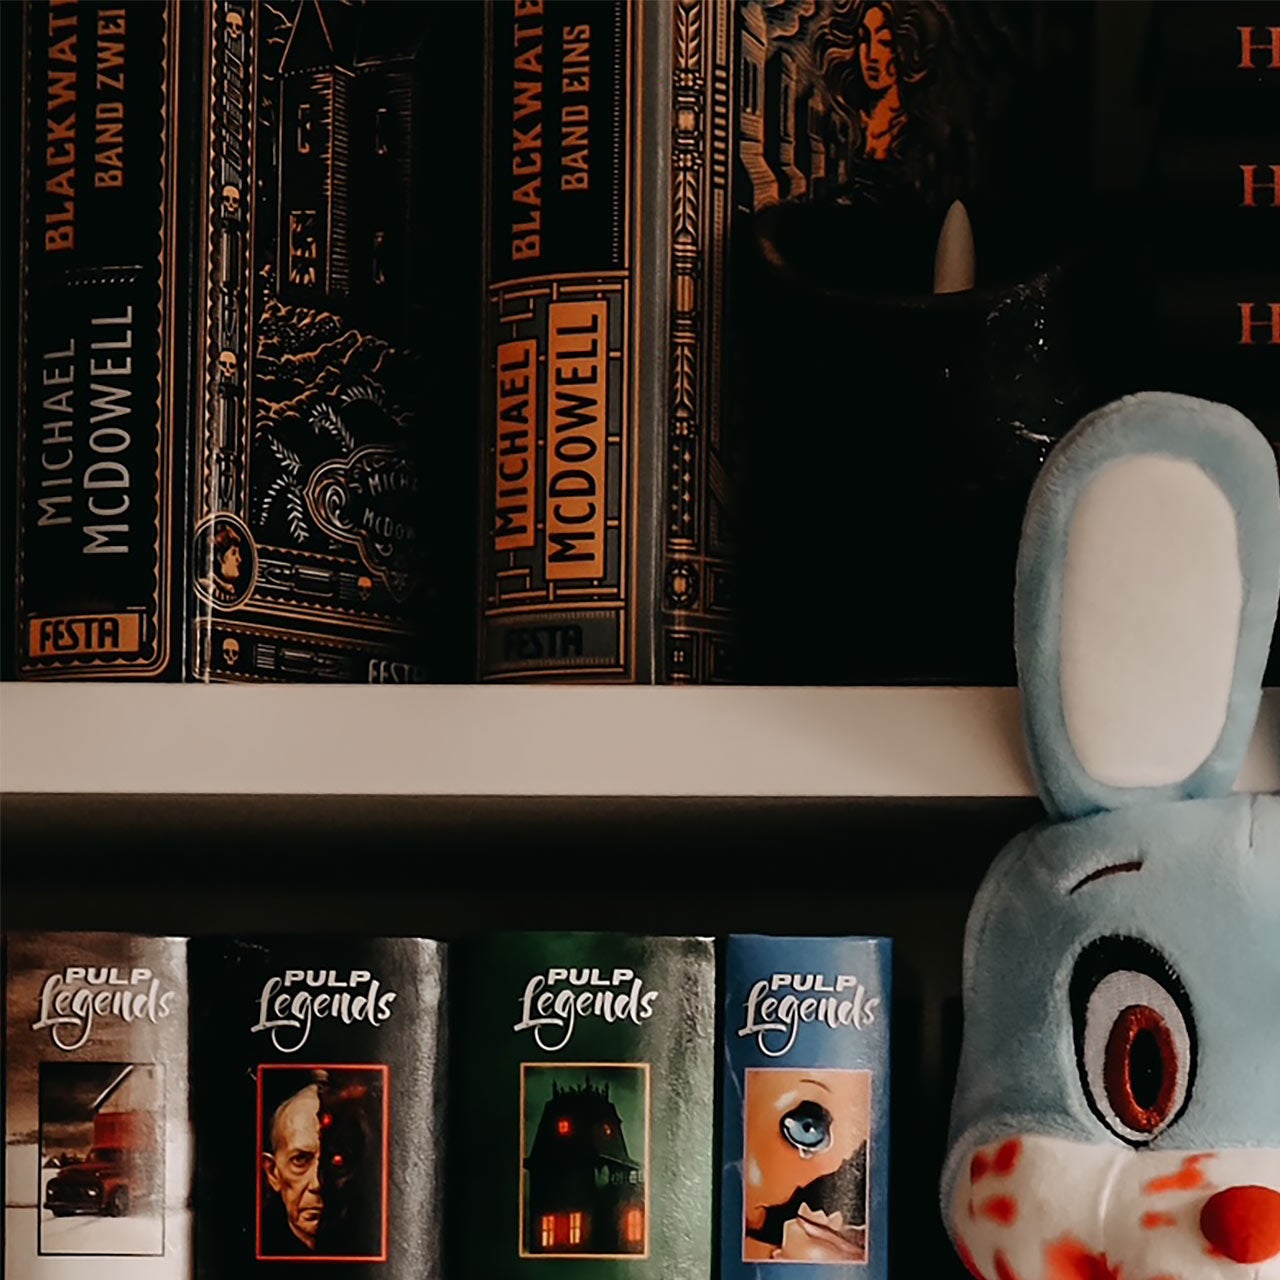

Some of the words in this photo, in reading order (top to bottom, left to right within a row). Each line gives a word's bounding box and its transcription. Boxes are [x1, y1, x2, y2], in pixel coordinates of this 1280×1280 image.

[96, 8, 128, 92] ZWEI
[562, 23, 592, 94] EINS
[94, 100, 127, 190] BAND
[560, 103, 591, 192] BAND
[36, 337, 76, 528] MICHAEL
[81, 304, 134, 556] MCDOWELL
[495, 348, 529, 539] MICHAEL
[548, 314, 600, 563] MCDOWELL
[39, 617, 120, 652] FESTA
[33, 974, 175, 1051] Legends
[66, 967, 153, 985] PULP
[284, 970, 371, 988] PULP
[513, 975, 659, 1051] Legends
[547, 968, 635, 986] PULP
[770, 974, 857, 991] PULP
[251, 977, 397, 1053] Legends
[738, 981, 880, 1057] Legends
